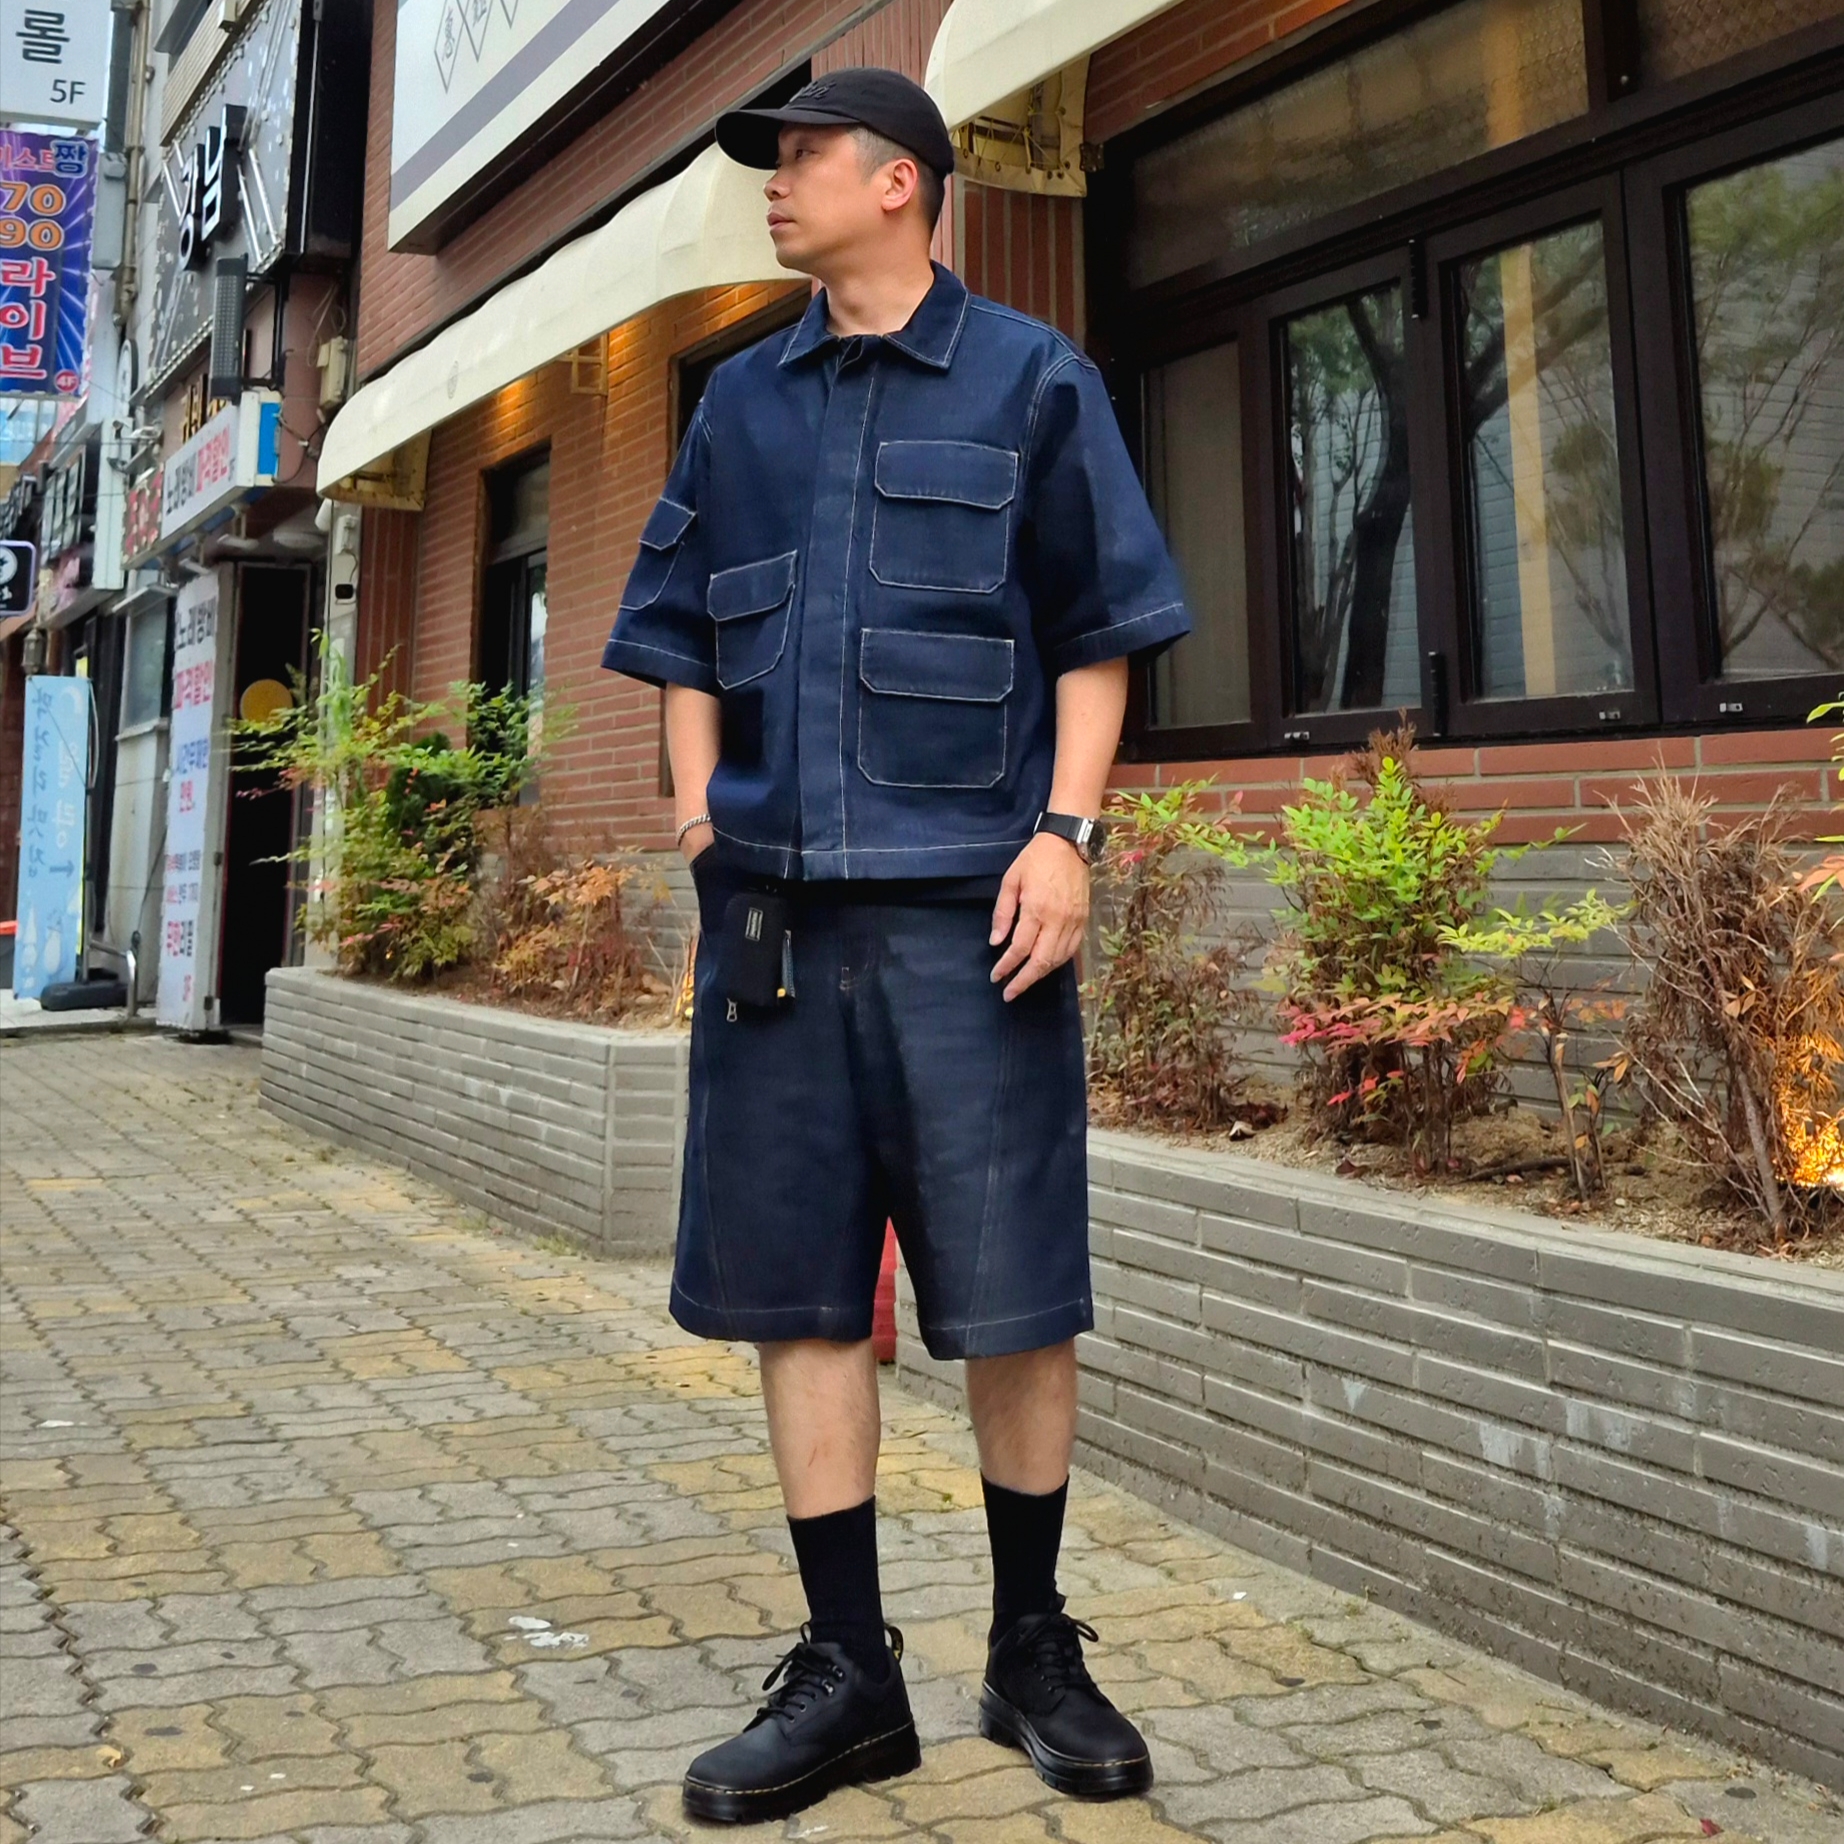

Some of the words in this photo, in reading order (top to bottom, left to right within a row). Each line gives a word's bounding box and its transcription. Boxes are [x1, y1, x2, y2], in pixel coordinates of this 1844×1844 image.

[49, 79, 86, 104] 5F
[0, 182, 65, 215] 70
[0, 216, 64, 250] 90
[0, 256, 56, 379] 라이브
